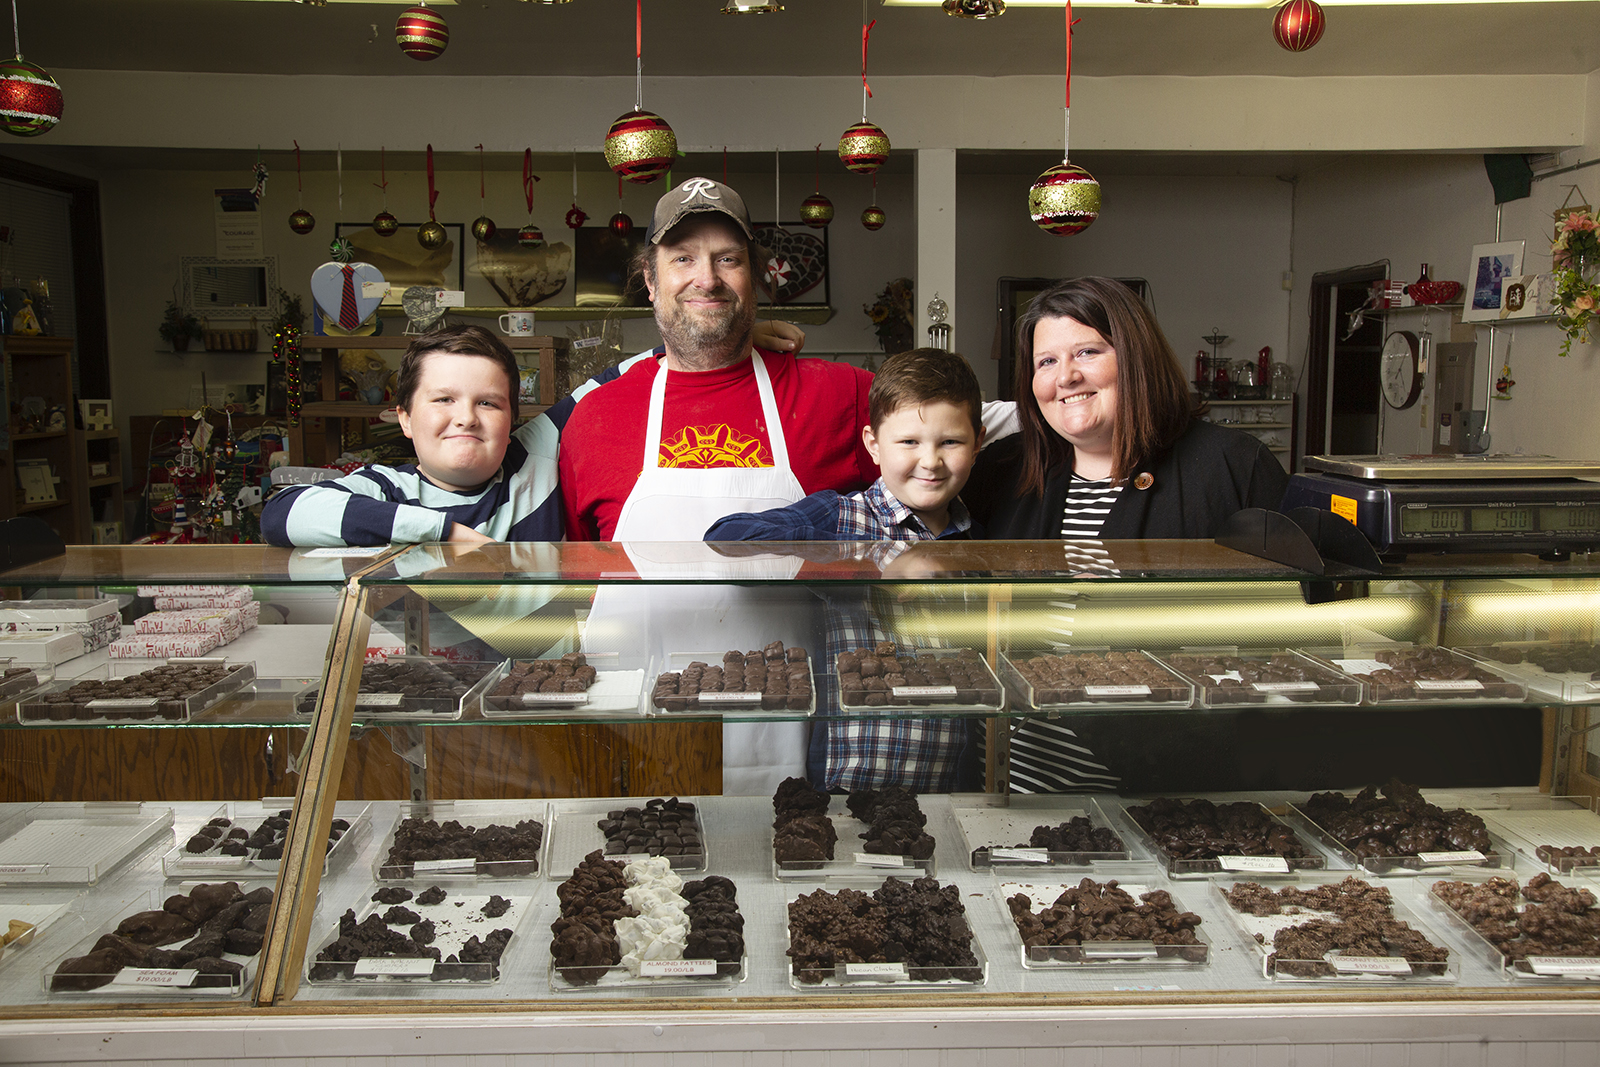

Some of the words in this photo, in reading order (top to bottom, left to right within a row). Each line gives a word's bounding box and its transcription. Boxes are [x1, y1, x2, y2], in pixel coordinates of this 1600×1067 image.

[680, 179, 721, 204] R
[1431, 510, 1459, 528] 0.00
[1495, 510, 1528, 528] 15.00
